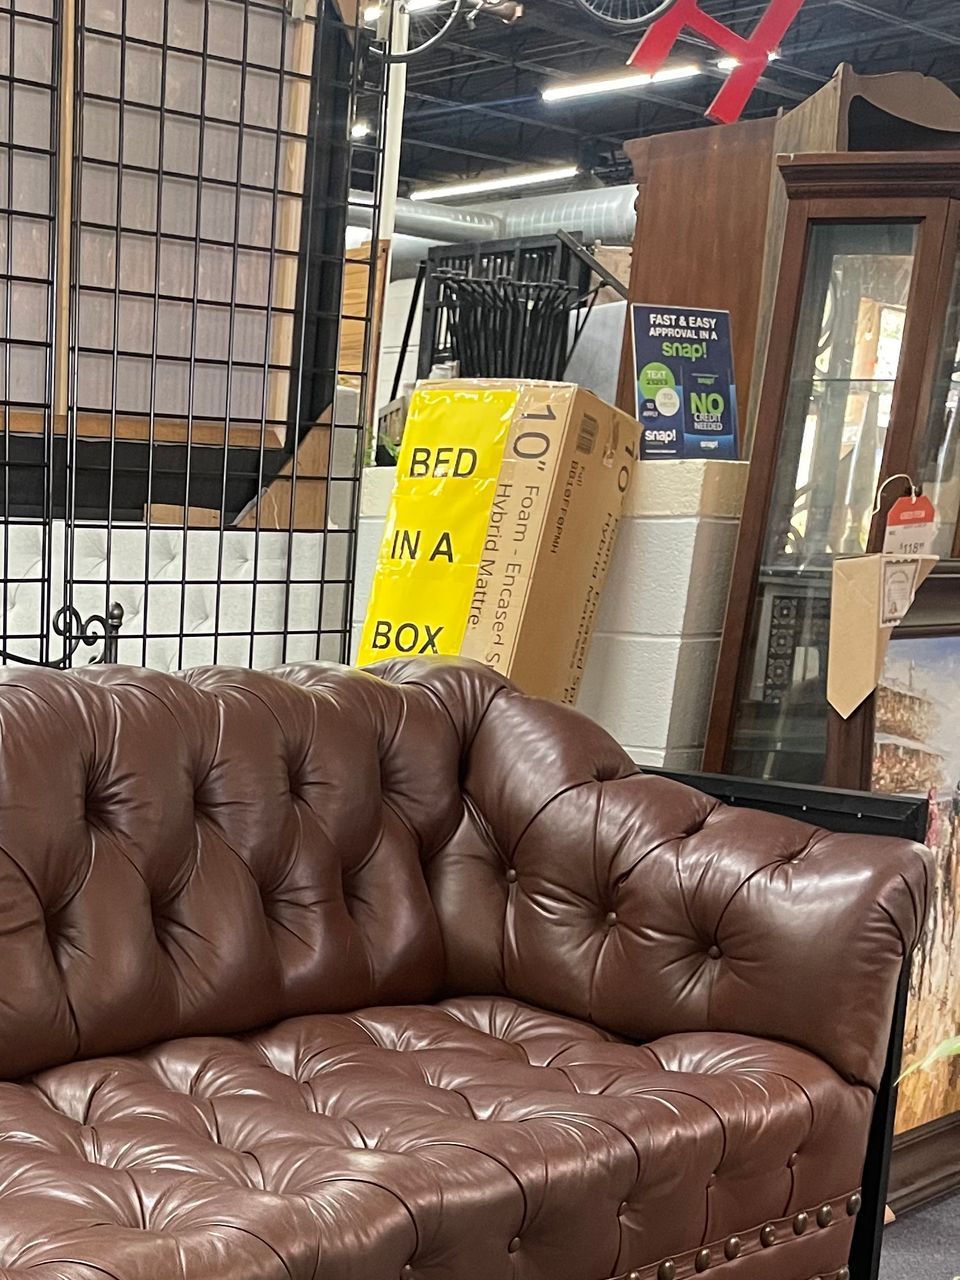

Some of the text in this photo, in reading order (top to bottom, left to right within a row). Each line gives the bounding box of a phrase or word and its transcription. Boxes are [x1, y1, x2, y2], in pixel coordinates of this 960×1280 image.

[649, 313, 716, 329] FAST & EASY
[649, 327, 718, 340] APPROVAL IN A
[662, 341, 707, 362] snap!
[646, 370, 666, 378] TEXT
[690, 392, 725, 415] NO
[694, 413, 721, 422] CREDIT
[694, 422, 723, 431] NEEDED
[644, 429, 676, 444] snap!
[409, 447, 478, 479] BED
[484, 483, 513, 552] Hybrid
[512, 485, 540, 542] Foam
[391, 529, 454, 563] IN A
[371, 620, 444, 654] BOX
